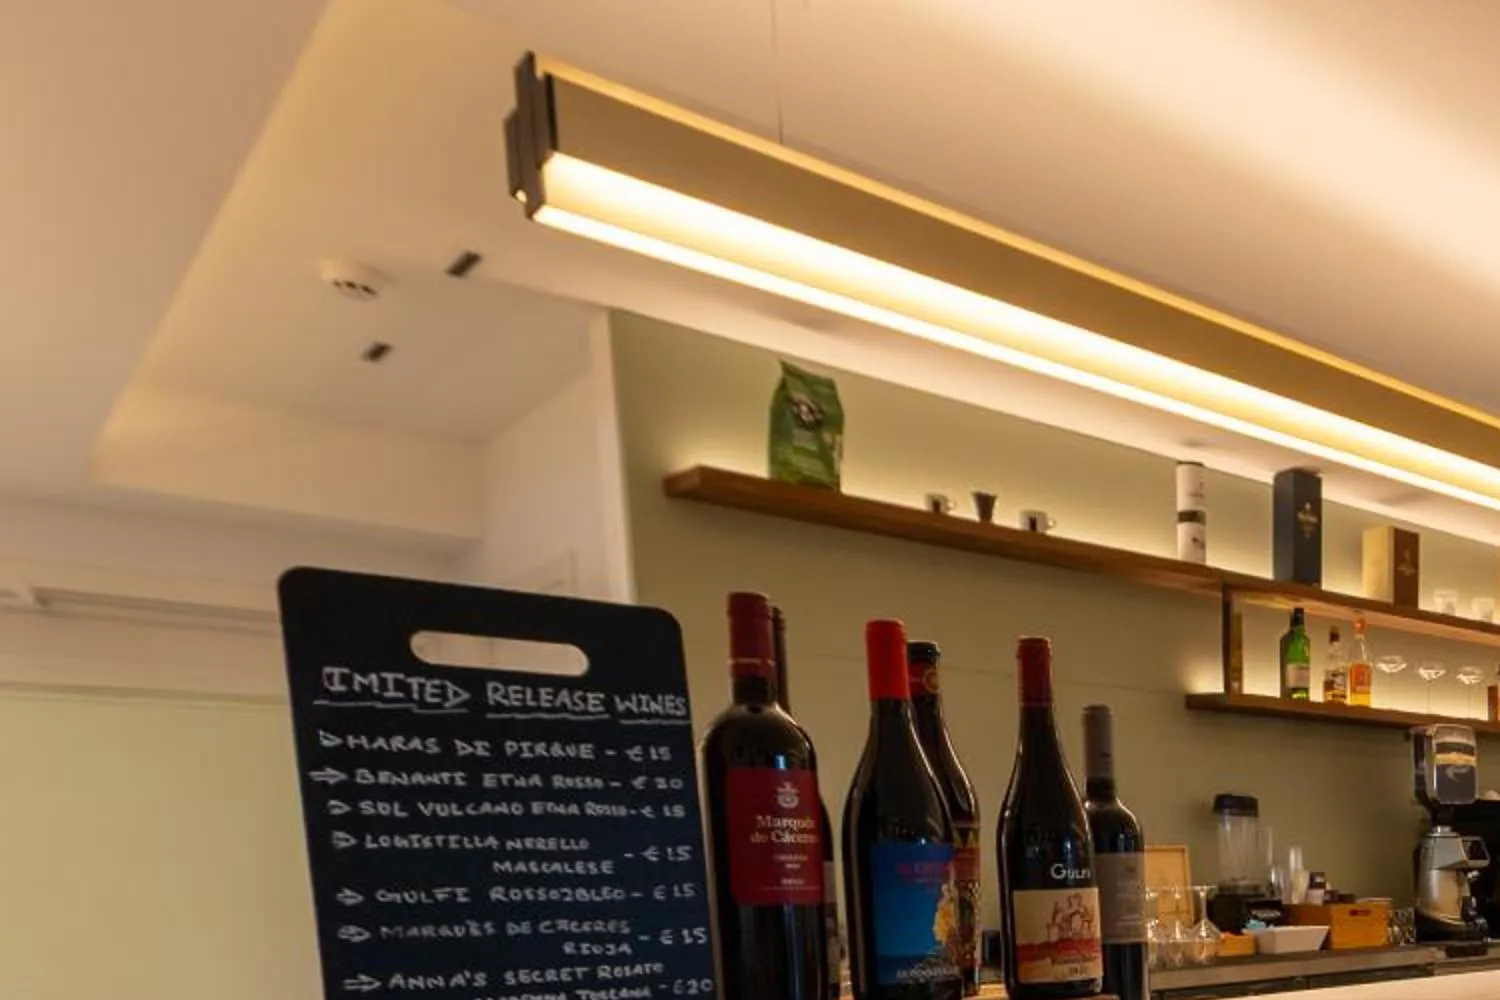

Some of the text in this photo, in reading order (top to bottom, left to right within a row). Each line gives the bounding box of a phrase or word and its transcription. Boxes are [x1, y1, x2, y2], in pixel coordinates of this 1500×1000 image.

[486, 681, 606, 713] RELEASE
[613, 693, 687, 717] WINES
[453, 738, 491, 757] DE
[354, 768, 467, 787] BENANTI
[482, 772, 544, 789] ETNA
[375, 886, 471, 904] GULFI
[505, 920, 533, 936] DE
[562, 941, 633, 957] RIOJA
[503, 966, 590, 986] SECRET
